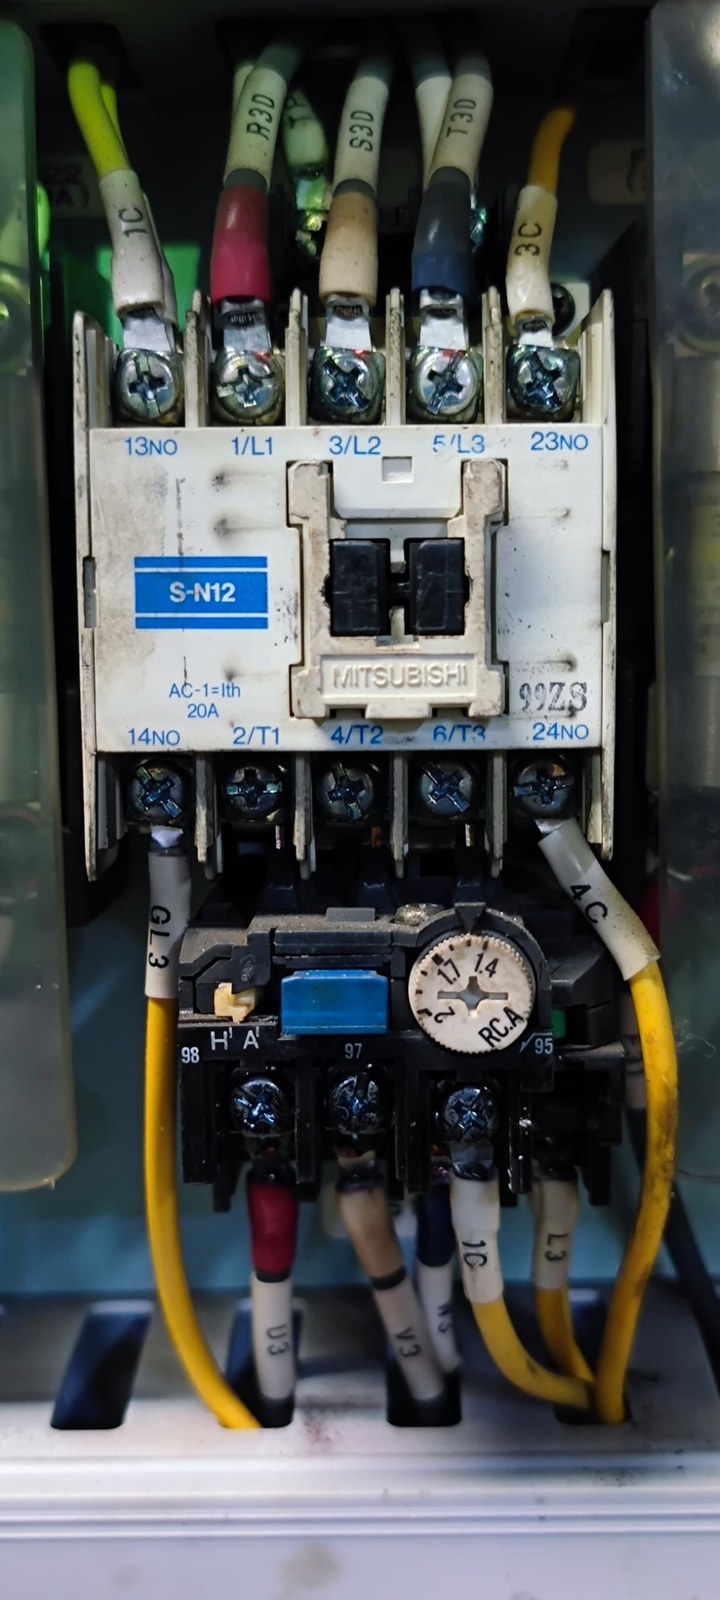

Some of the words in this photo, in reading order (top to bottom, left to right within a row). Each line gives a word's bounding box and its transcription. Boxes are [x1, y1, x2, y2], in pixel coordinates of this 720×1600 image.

[246, 94, 275, 140] R3D
[446, 100, 477, 138] T3D
[350, 110, 374, 152] S3D
[118, 207, 148, 238] 1C
[514, 223, 543, 257] 3C
[124, 436, 178, 456] 13NO
[231, 436, 273, 456] 1/L1
[329, 435, 381, 456] 3/L2
[432, 434, 485, 454] 5/L3
[531, 432, 589, 452] 23NO
[169, 582, 236, 603] S-N12
[331, 663, 468, 690] MITSUBISHI
[187, 703, 219, 719] 20A
[128, 728, 181, 747] 14NO
[232, 726, 280, 746] 2/T1
[331, 725, 384, 745] 4/T2
[433, 725, 486, 743] 6/T3
[532, 722, 589, 741] 24NO
[570, 883, 608, 924] 4C
[437, 957, 461, 985] 1.7
[473, 952, 499, 979] 1.4
[434, 1006, 456, 1024] 2
[478, 1006, 524, 1048] RC.A
[181, 1047, 200, 1064] 98
[344, 1043, 362, 1059] 97
[535, 1038, 553, 1054] 95
[545, 1232, 568, 1262] L3
[266, 1323, 289, 1356] U3
[394, 1326, 420, 1359] V3
